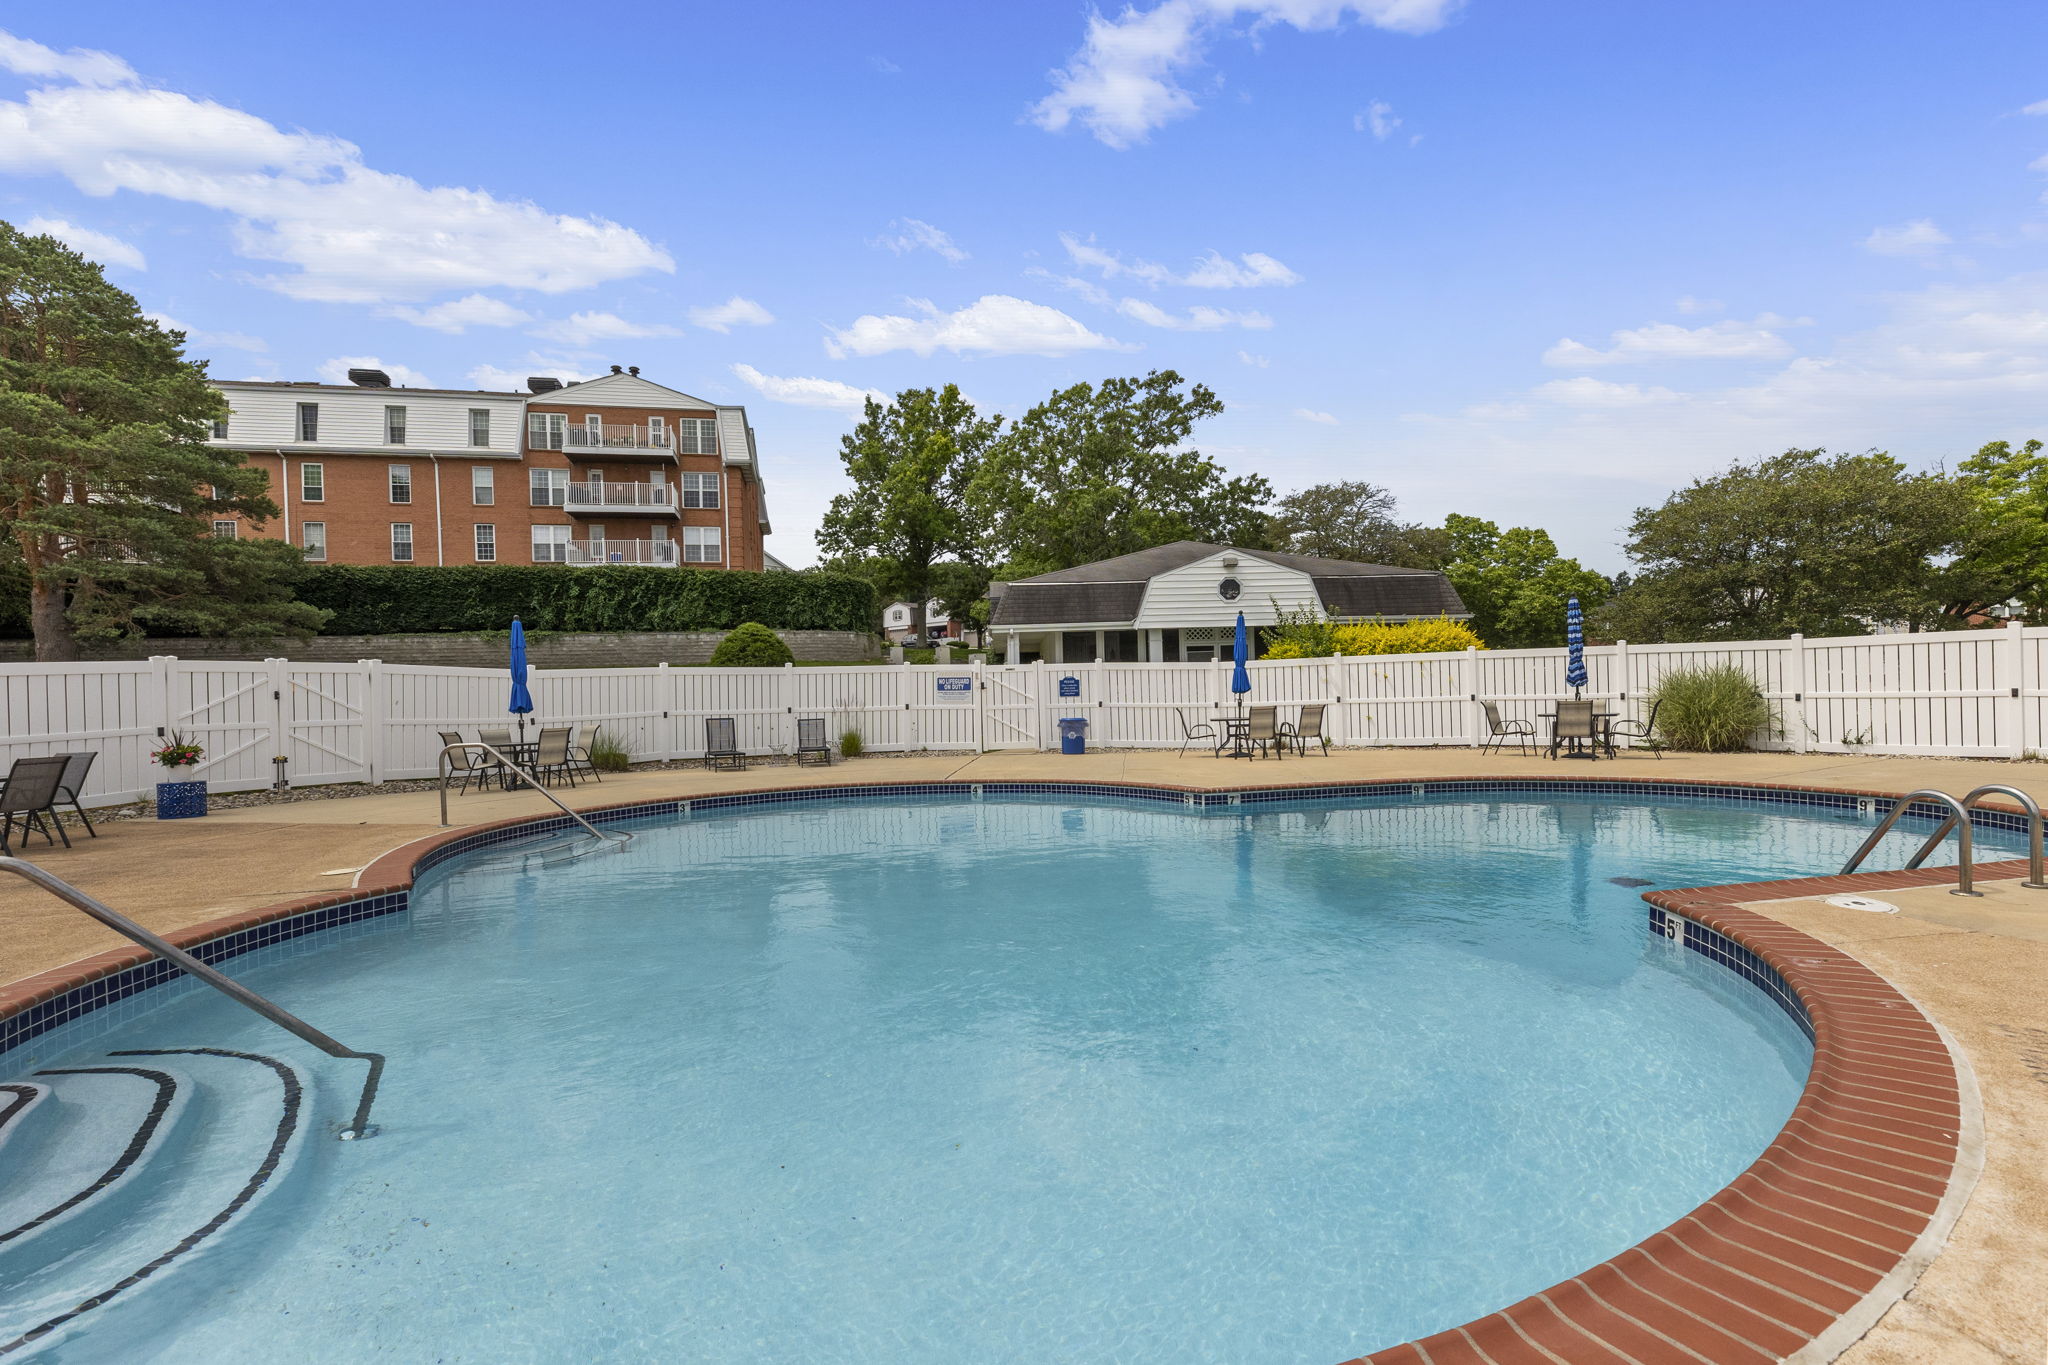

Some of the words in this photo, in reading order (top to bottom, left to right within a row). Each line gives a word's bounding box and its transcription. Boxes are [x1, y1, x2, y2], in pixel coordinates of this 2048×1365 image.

[972, 785, 978, 794] 4
[1185, 795, 1190, 804] 5
[1229, 795, 1235, 805] 7
[680, 803, 685, 812] 3
[1859, 800, 1867, 811] 9
[1667, 917, 1675, 940] 5
